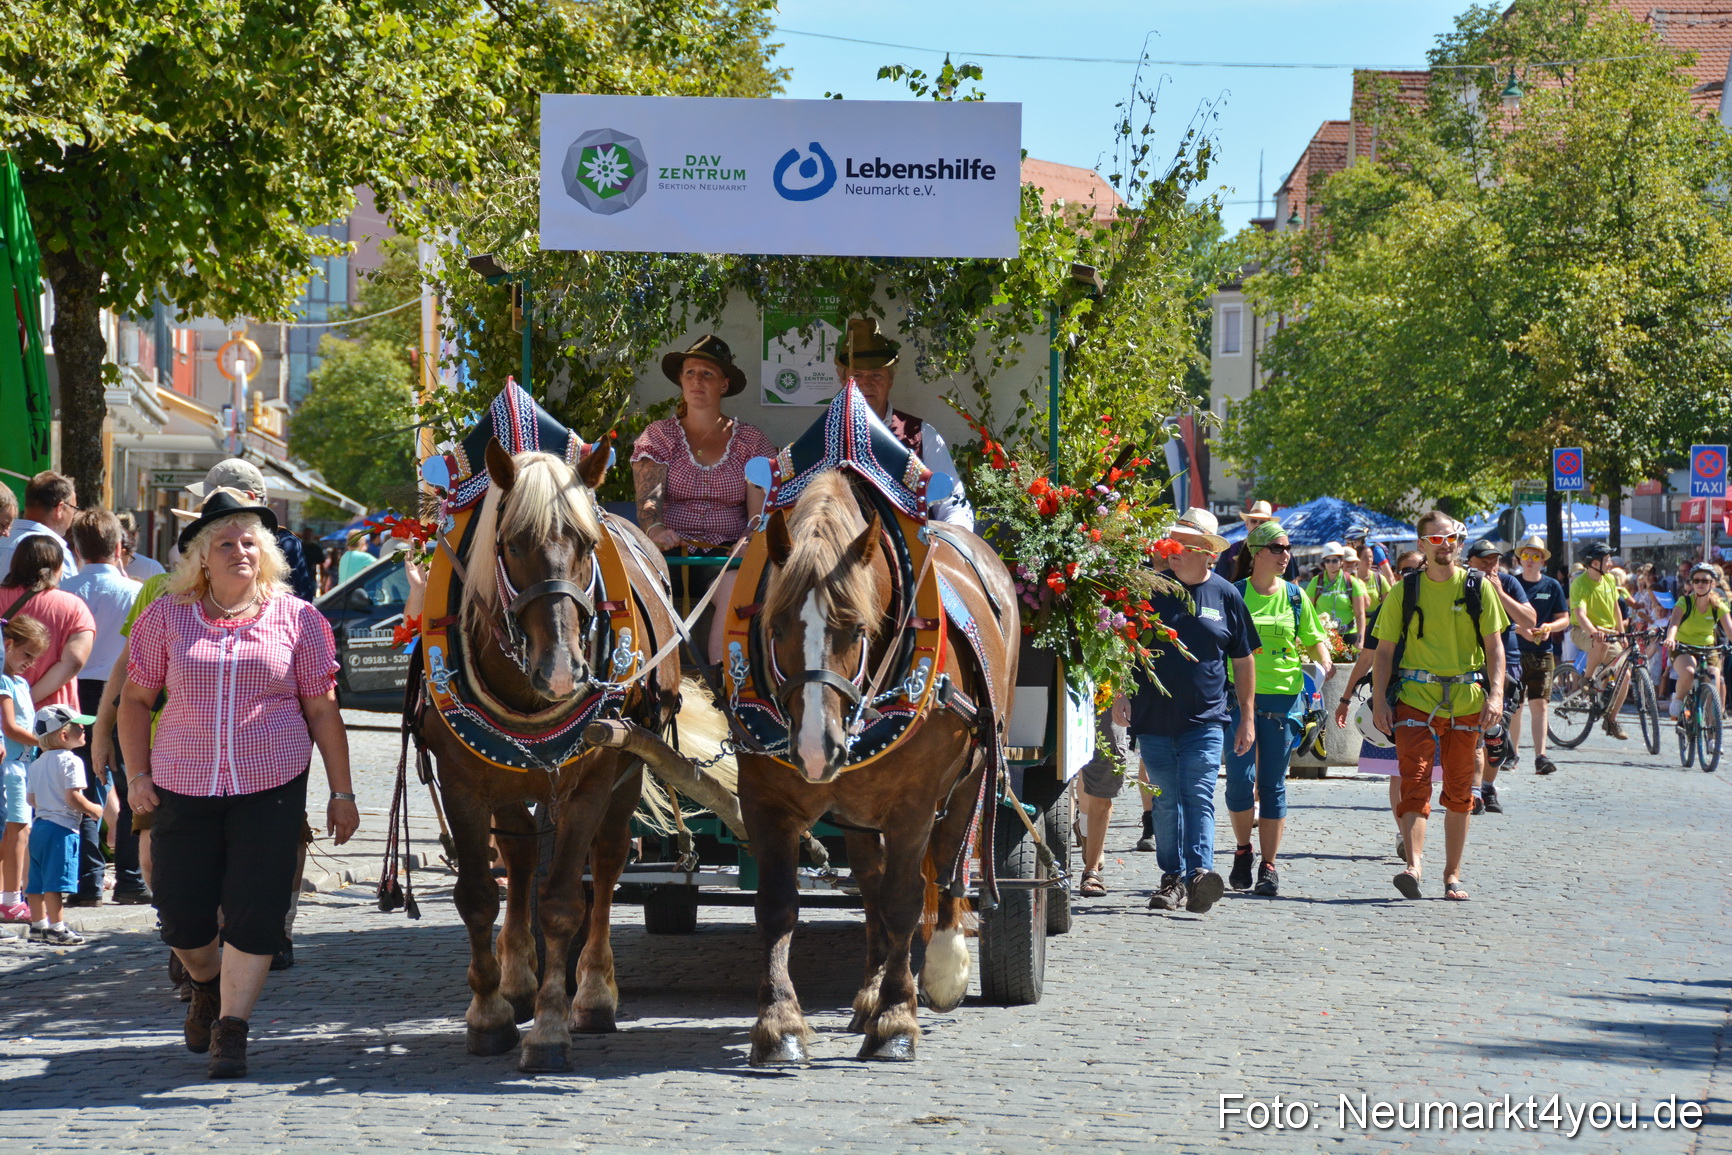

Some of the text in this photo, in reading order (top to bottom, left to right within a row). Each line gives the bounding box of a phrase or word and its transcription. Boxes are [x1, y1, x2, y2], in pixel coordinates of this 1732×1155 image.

[685, 155, 721, 166] DAV
[659, 168, 746, 180] ZENTRUM
[846, 157, 996, 180] Lebenshilfe
[699, 183, 747, 191] NEUMARKT
[845, 183, 936, 196] Neumarkt e.V.
[154, 474, 175, 483] NZ
[1557, 477, 1581, 487] TAXI
[1694, 481, 1723, 493] TAXI
[363, 656, 387, 665] 09181
[393, 655, 408, 663] 520
